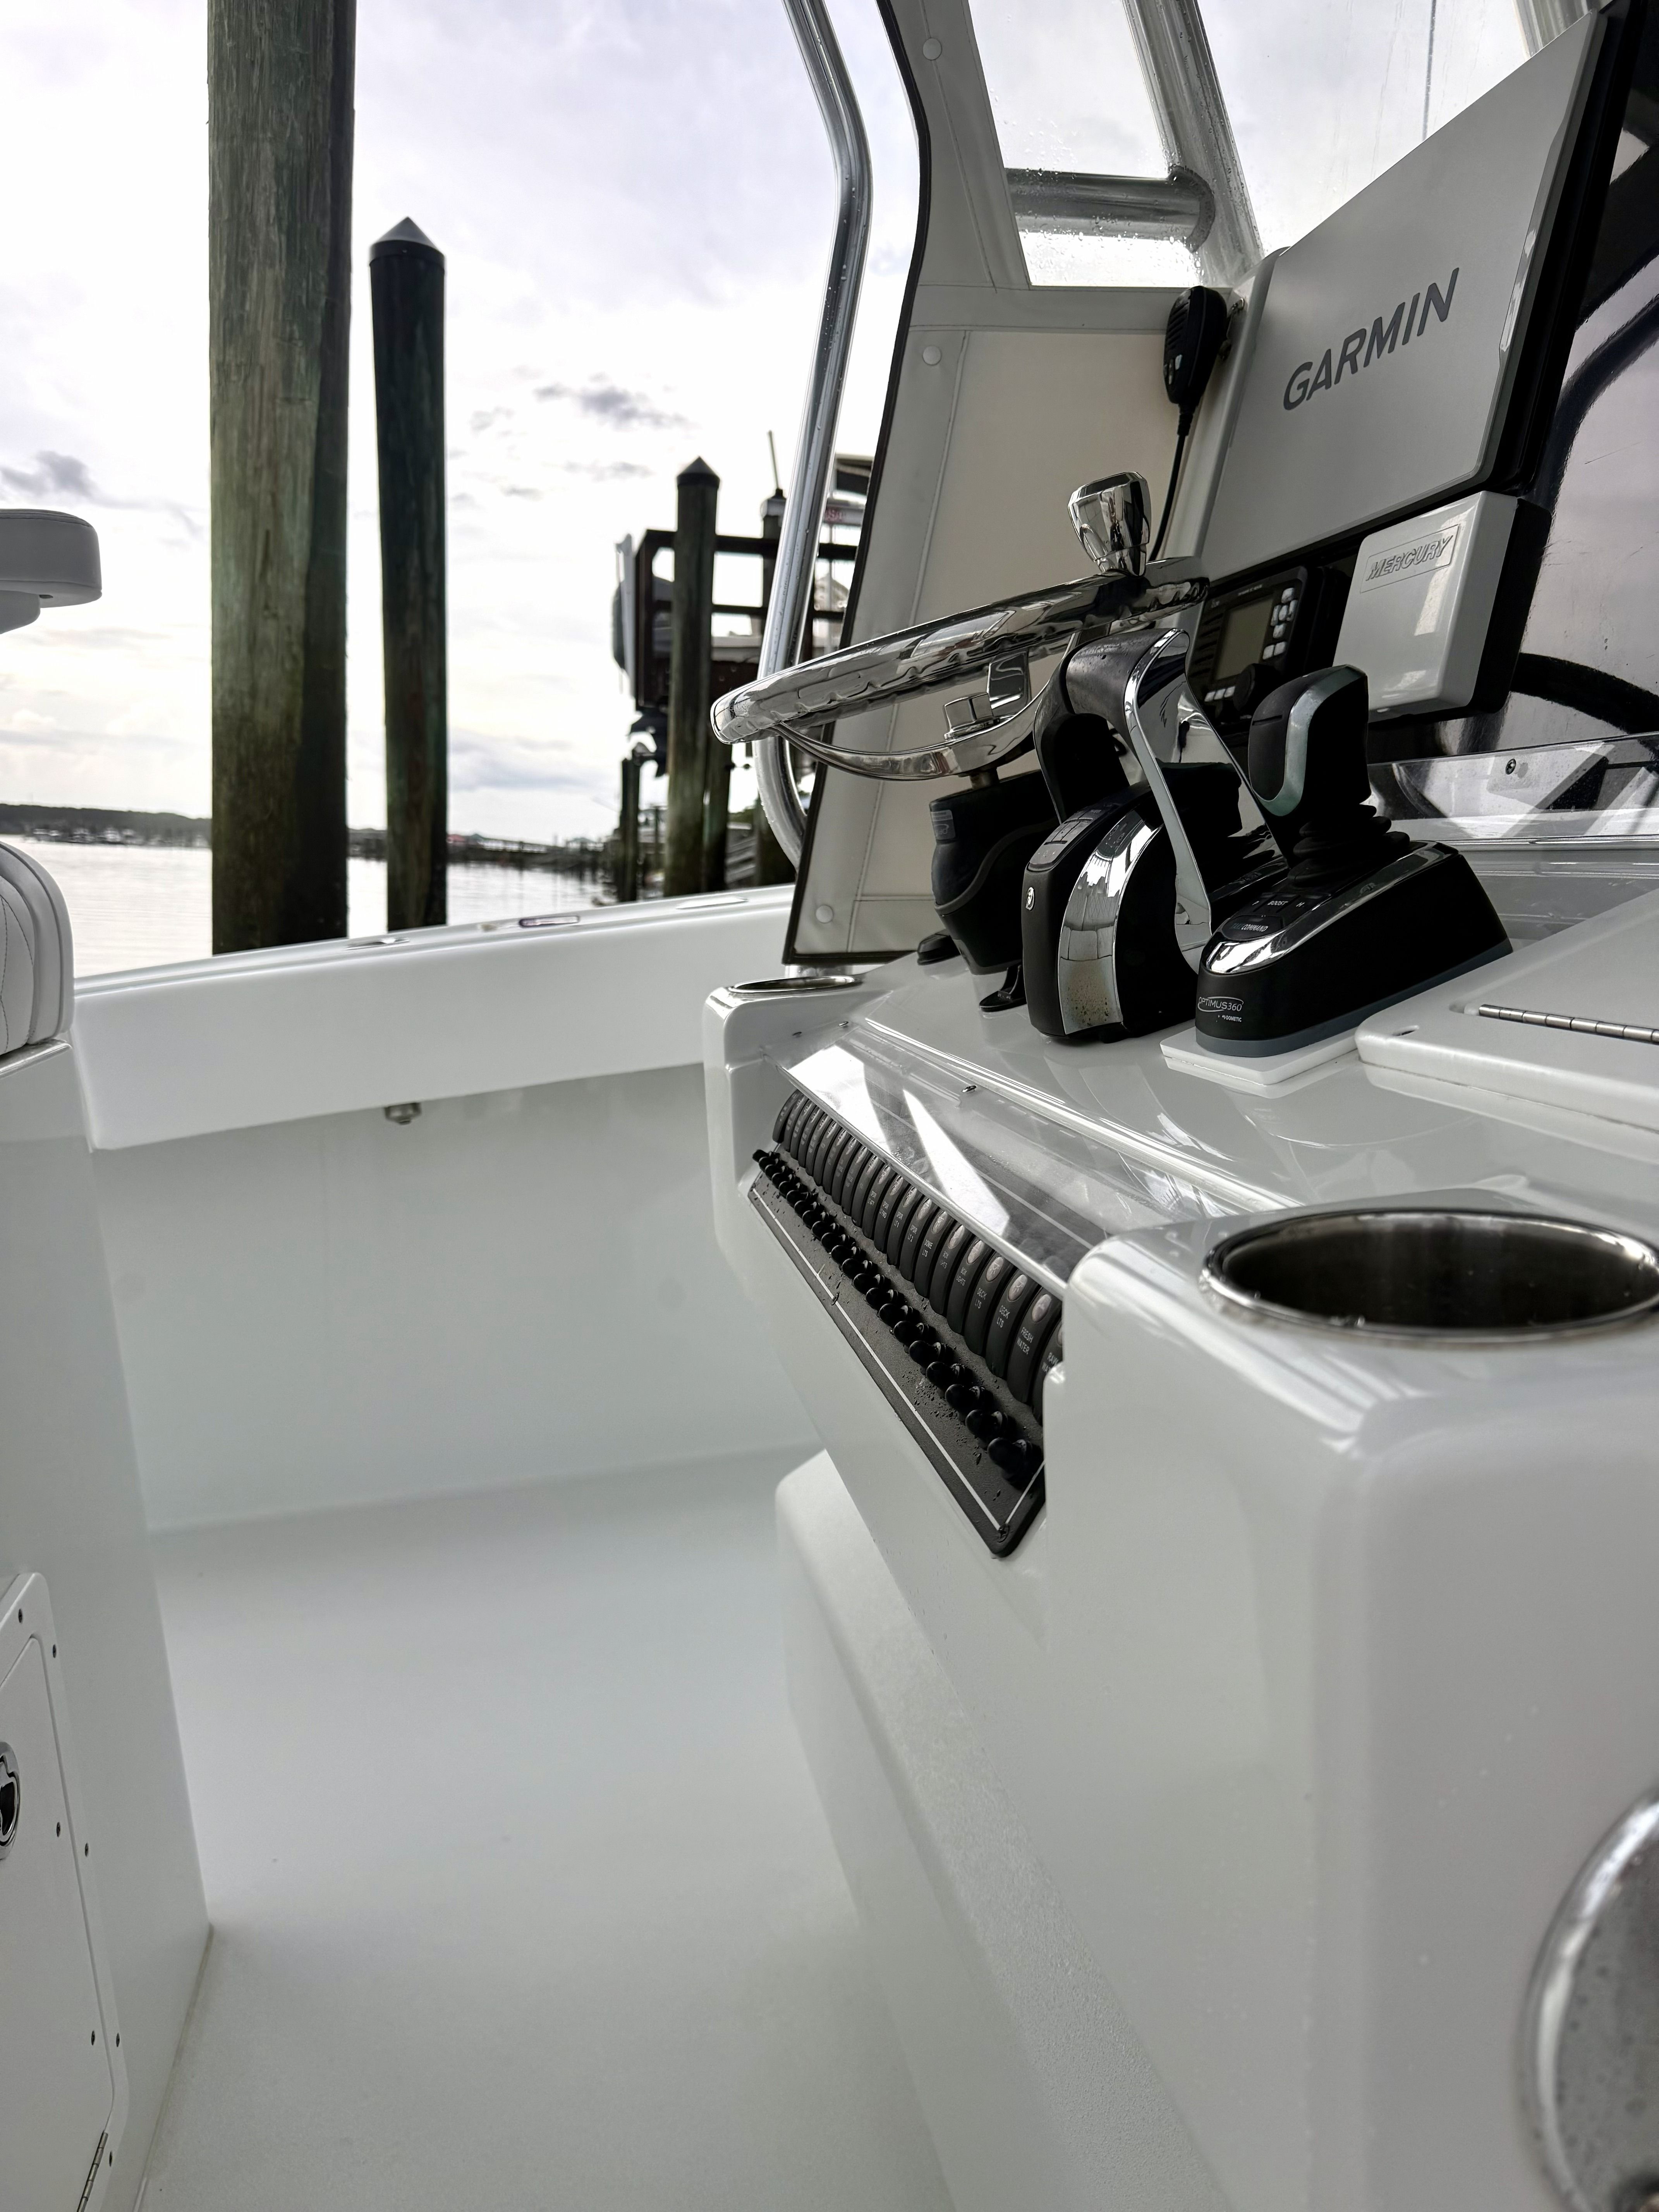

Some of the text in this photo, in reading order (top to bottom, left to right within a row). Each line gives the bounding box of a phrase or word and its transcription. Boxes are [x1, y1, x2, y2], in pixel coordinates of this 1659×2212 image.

[1283, 267, 1459, 410] GARMIN
[1365, 535, 1453, 581] MERCURY
[1199, 997, 1242, 1012] OPTIMUS360
[924, 1239, 933, 1249] DOME
[977, 1288, 987, 1300] DECK
[999, 1305, 1010, 1319] DECK
[1020, 1327, 1034, 1343] FRESH
[1017, 1337, 1030, 1355] WATER
